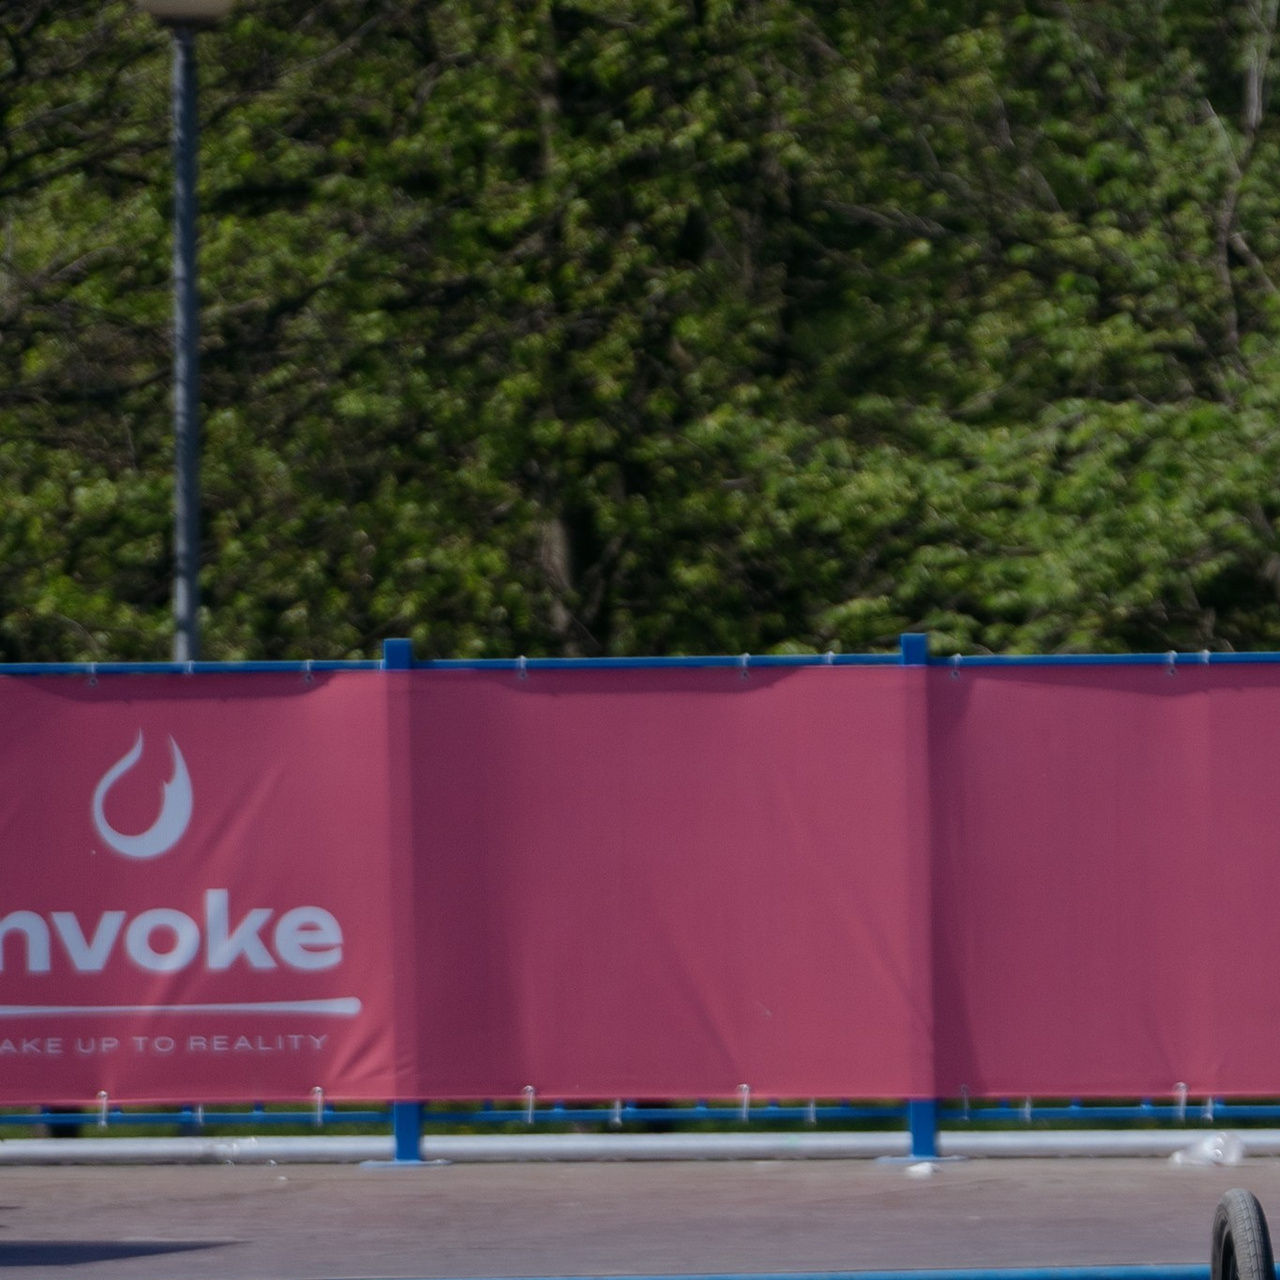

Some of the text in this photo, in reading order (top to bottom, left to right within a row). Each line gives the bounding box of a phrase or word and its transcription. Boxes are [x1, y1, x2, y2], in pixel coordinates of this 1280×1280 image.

[0, 888, 343, 974] nvoke
[78, 1037, 119, 1053] UP
[131, 1036, 175, 1053] TO
[188, 1034, 328, 1052] REALITY
